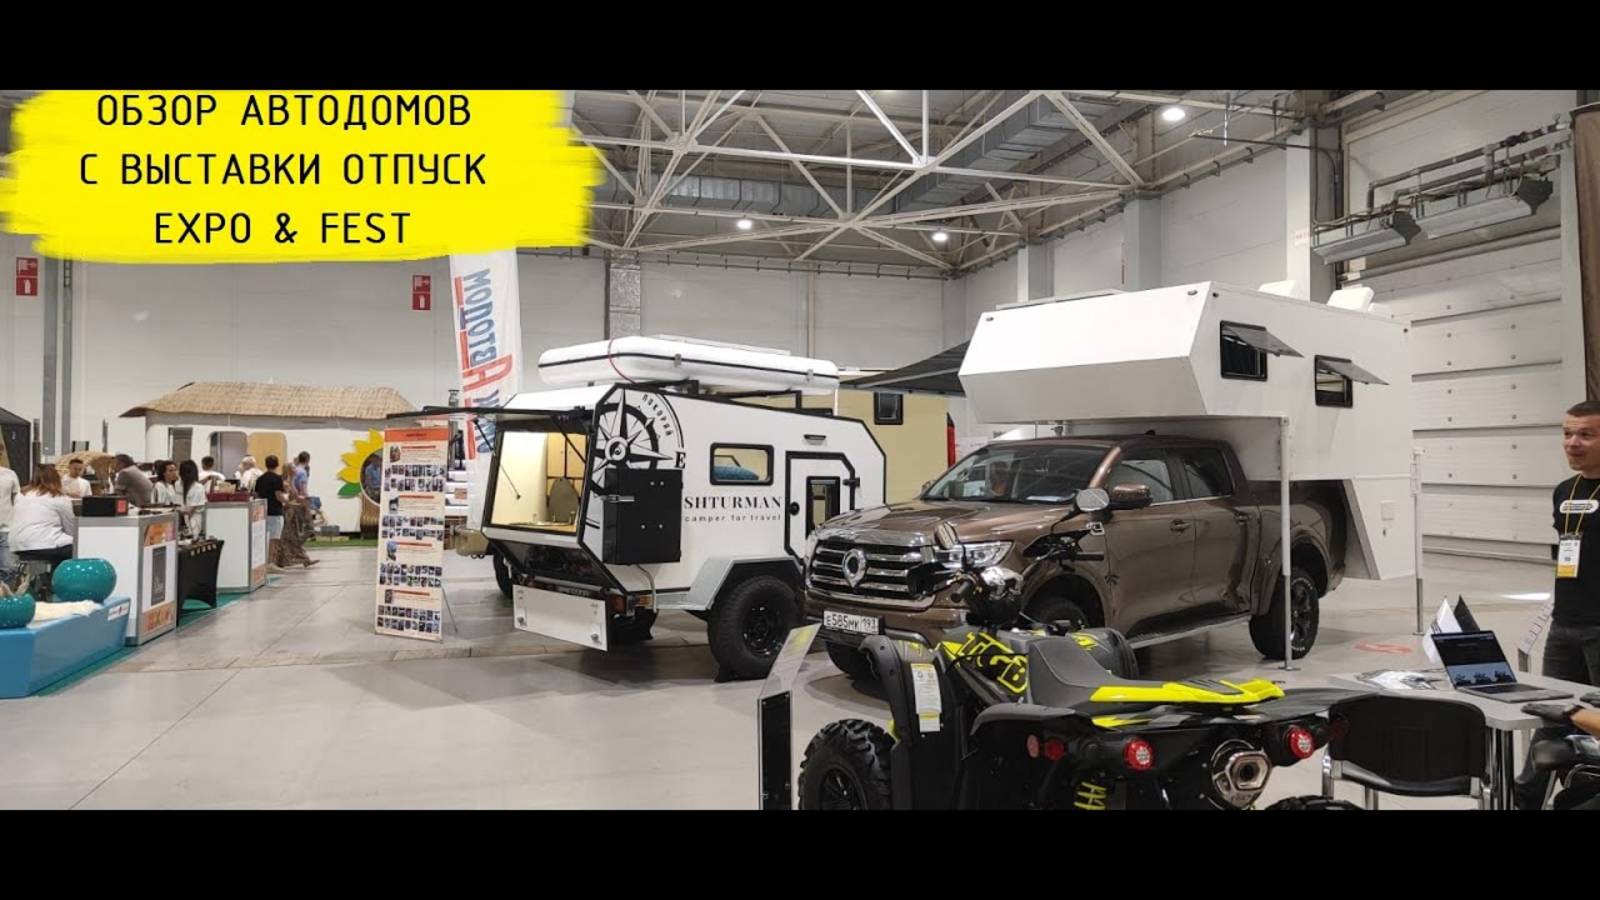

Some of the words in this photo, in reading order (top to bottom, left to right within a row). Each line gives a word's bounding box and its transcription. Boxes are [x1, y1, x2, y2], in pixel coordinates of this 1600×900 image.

[675, 451, 686, 469] E
[684, 496, 782, 509] SHTURMAN
[684, 515, 725, 523] camper
